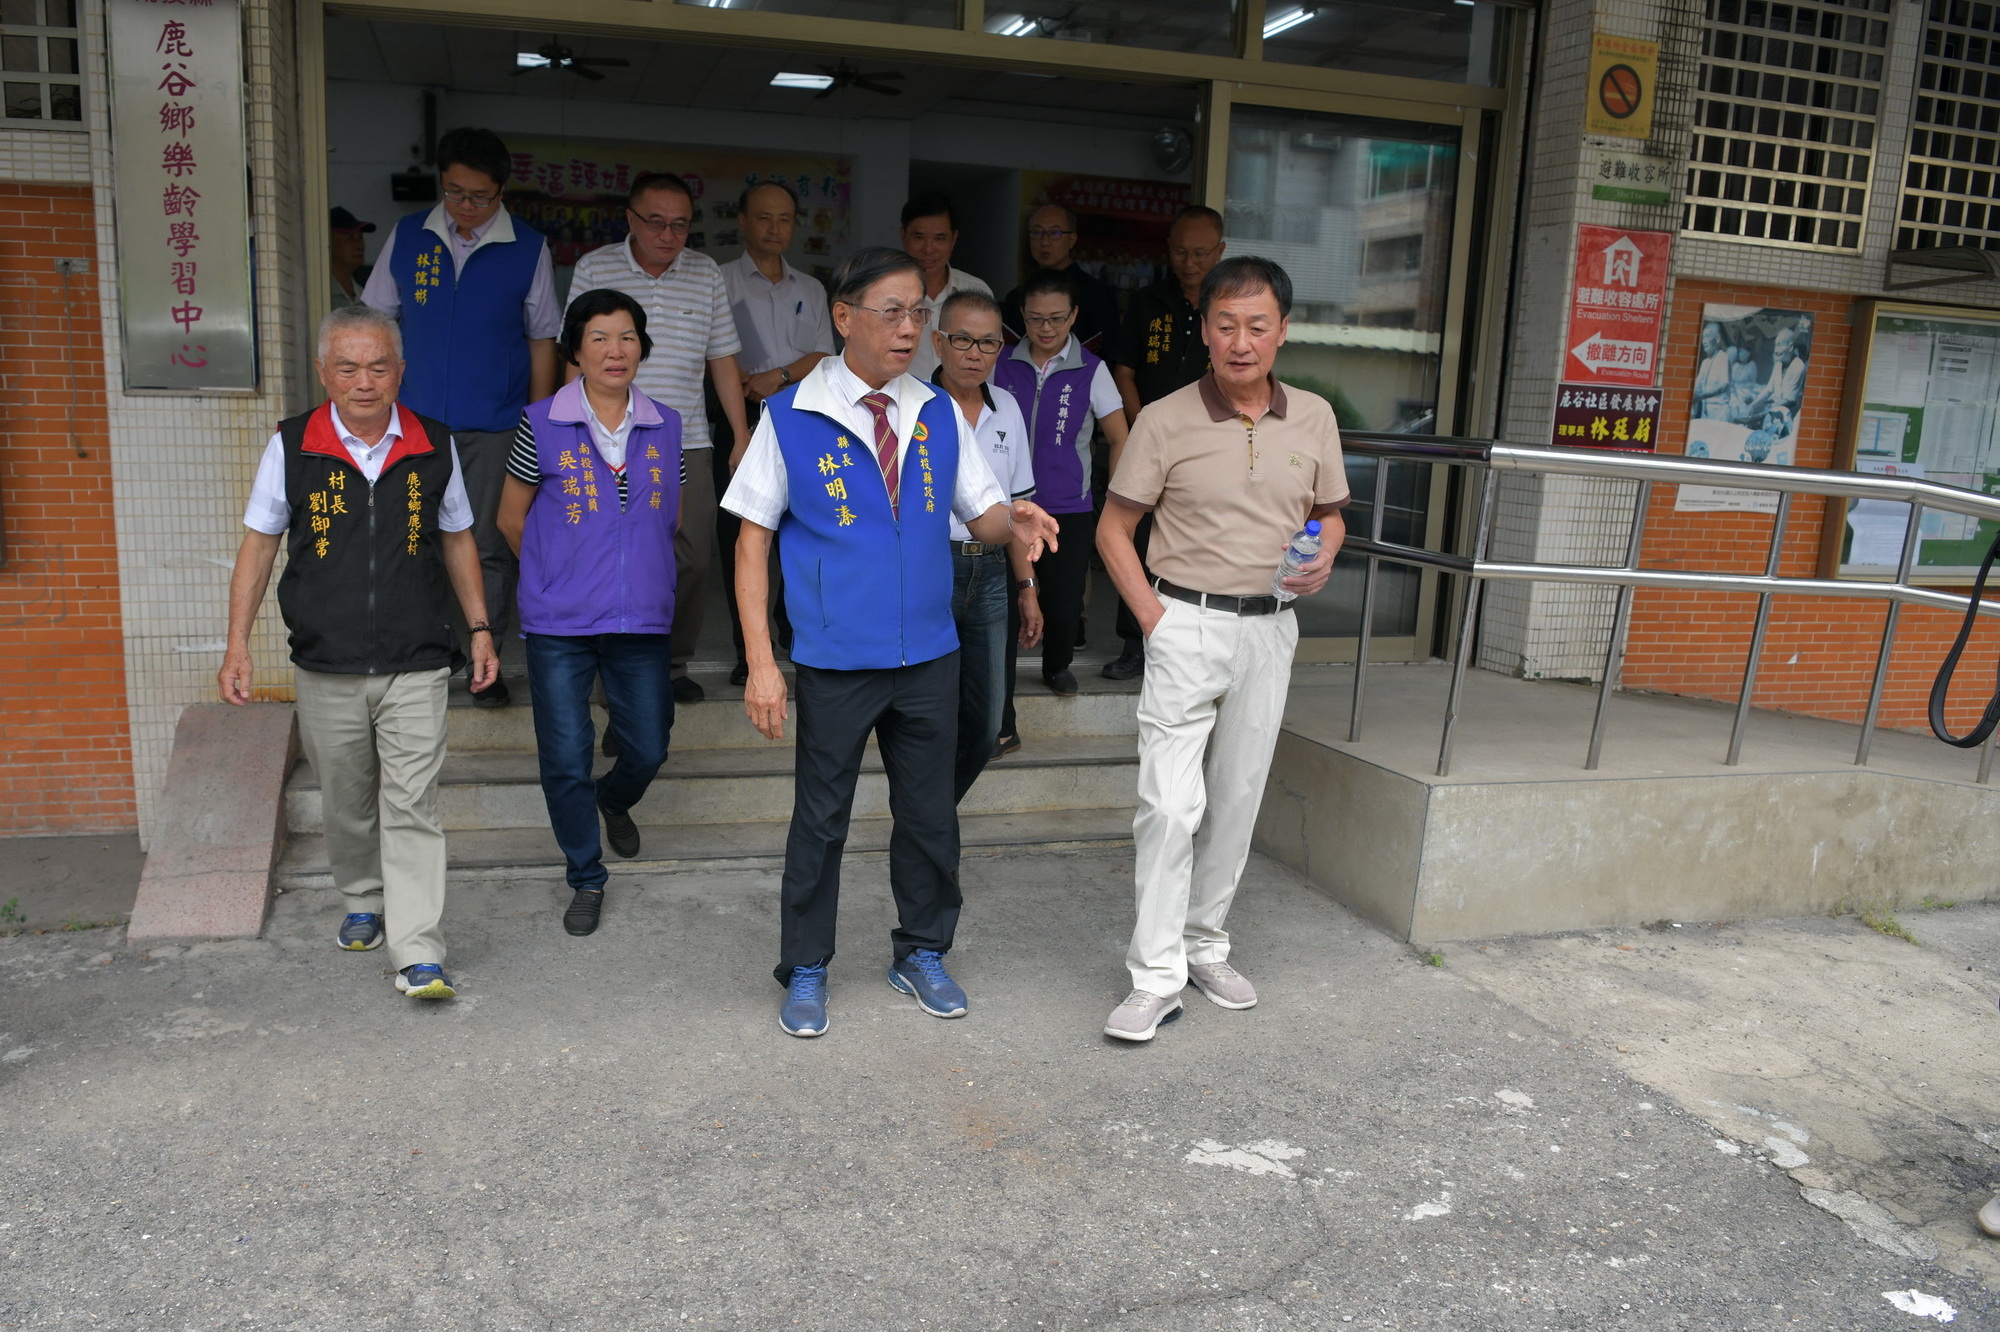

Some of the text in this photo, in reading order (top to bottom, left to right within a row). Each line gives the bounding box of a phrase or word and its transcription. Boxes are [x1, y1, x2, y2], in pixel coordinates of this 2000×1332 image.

[1598, 158, 1670, 186] 避難收容所
[156, 20, 207, 368] 鹿谷鄉樂齡學習中心
[1616, 190, 1648, 201] Shelter
[415, 253, 431, 306] 林儒彬
[1576, 286, 1659, 310] 避難收容處所
[1576, 308, 1654, 324] Evacuation Shelters
[1586, 342, 1647, 365] 撤離方向
[1601, 368, 1649, 379] Evacuation Route
[1559, 389, 1659, 413] 鹿谷社區發展協會
[1557, 424, 1586, 437] 理事長
[837, 435, 855, 467] 縣長
[328, 470, 348, 515] 村長
[558, 450, 582, 525] 吳瑞芳
[578, 442, 599, 512] 南投縣議員
[818, 453, 858, 527] 林明溱
[918, 443, 935, 513] 南投縣政府
[308, 490, 330, 559] 劉御常
[406, 471, 422, 556] 鹿谷鄉鹿谷村
